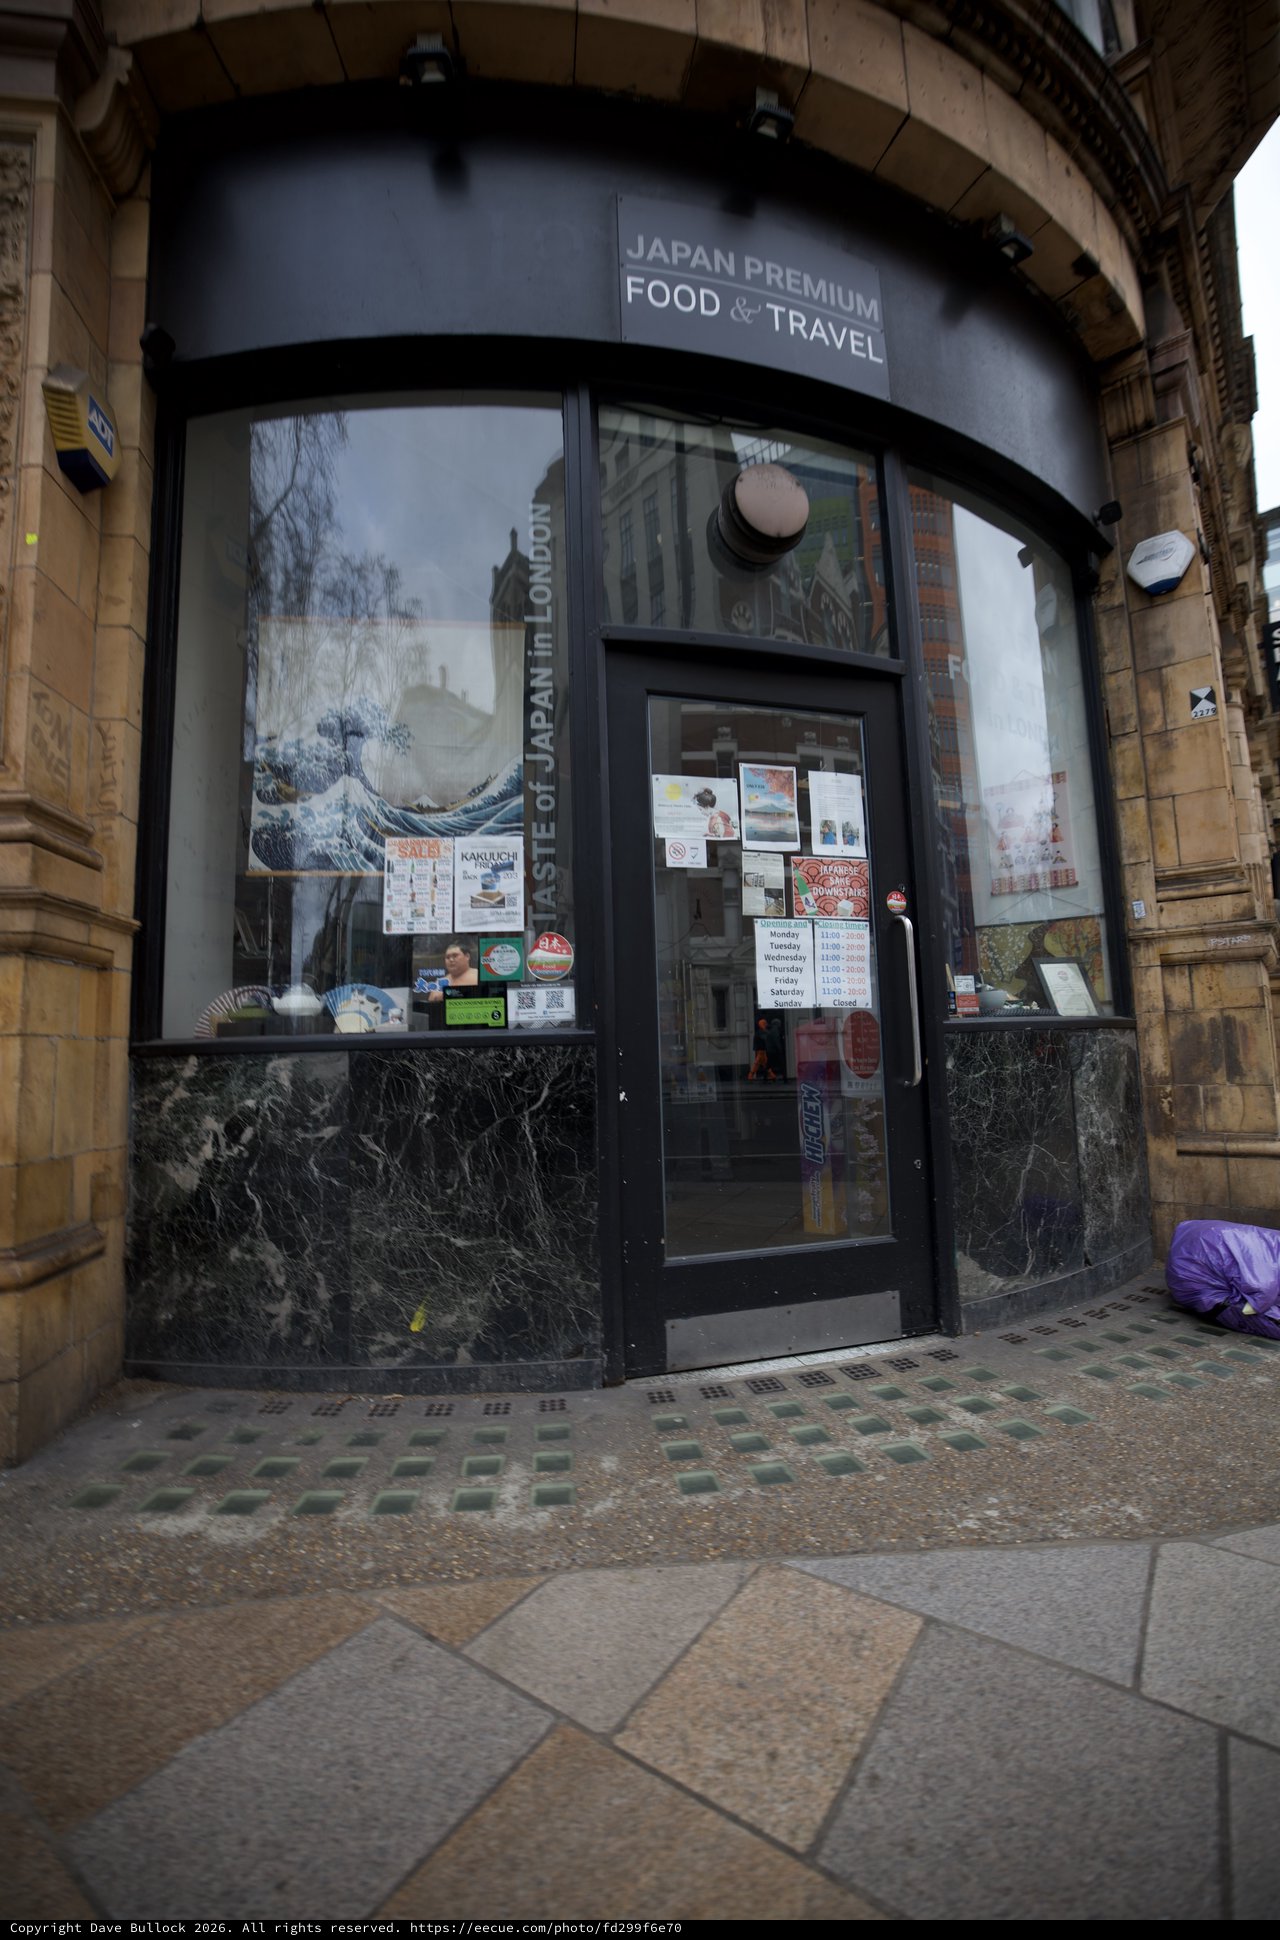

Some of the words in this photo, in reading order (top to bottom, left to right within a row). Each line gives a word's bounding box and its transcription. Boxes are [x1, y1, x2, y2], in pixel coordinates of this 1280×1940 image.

[626, 235, 735, 276] JAPAN
[744, 255, 880, 322] PREMIUM
[626, 275, 721, 317] FOOD
[730, 296, 762, 324] &
[766, 302, 884, 364] TRAVEL
[88, 408, 114, 449] ADT
[524, 503, 552, 624] LONDON
[527, 634, 553, 658] in
[525, 666, 555, 773] JAPAN
[529, 781, 556, 812] of
[461, 852, 518, 861] KAKUUCHI
[527, 821, 557, 924] TASTE
[820, 865, 860, 876] JAPANESE
[829, 876, 851, 886] SAKE
[812, 887, 867, 897] DOWNSTAIRS
[760, 920, 792, 929] Opening
[793, 920, 808, 928] and
[770, 931, 800, 939] Monday
[539, 937, 561, 950] 日本
[770, 942, 801, 950] Tuesday
[764, 954, 807, 962] Wednesday
[768, 965, 803, 973] Thursday
[775, 977, 799, 985] Friday
[770, 988, 804, 996] Saturday
[832, 999, 857, 1007] Closed
[801, 1083, 825, 1164] HI-CHEW
